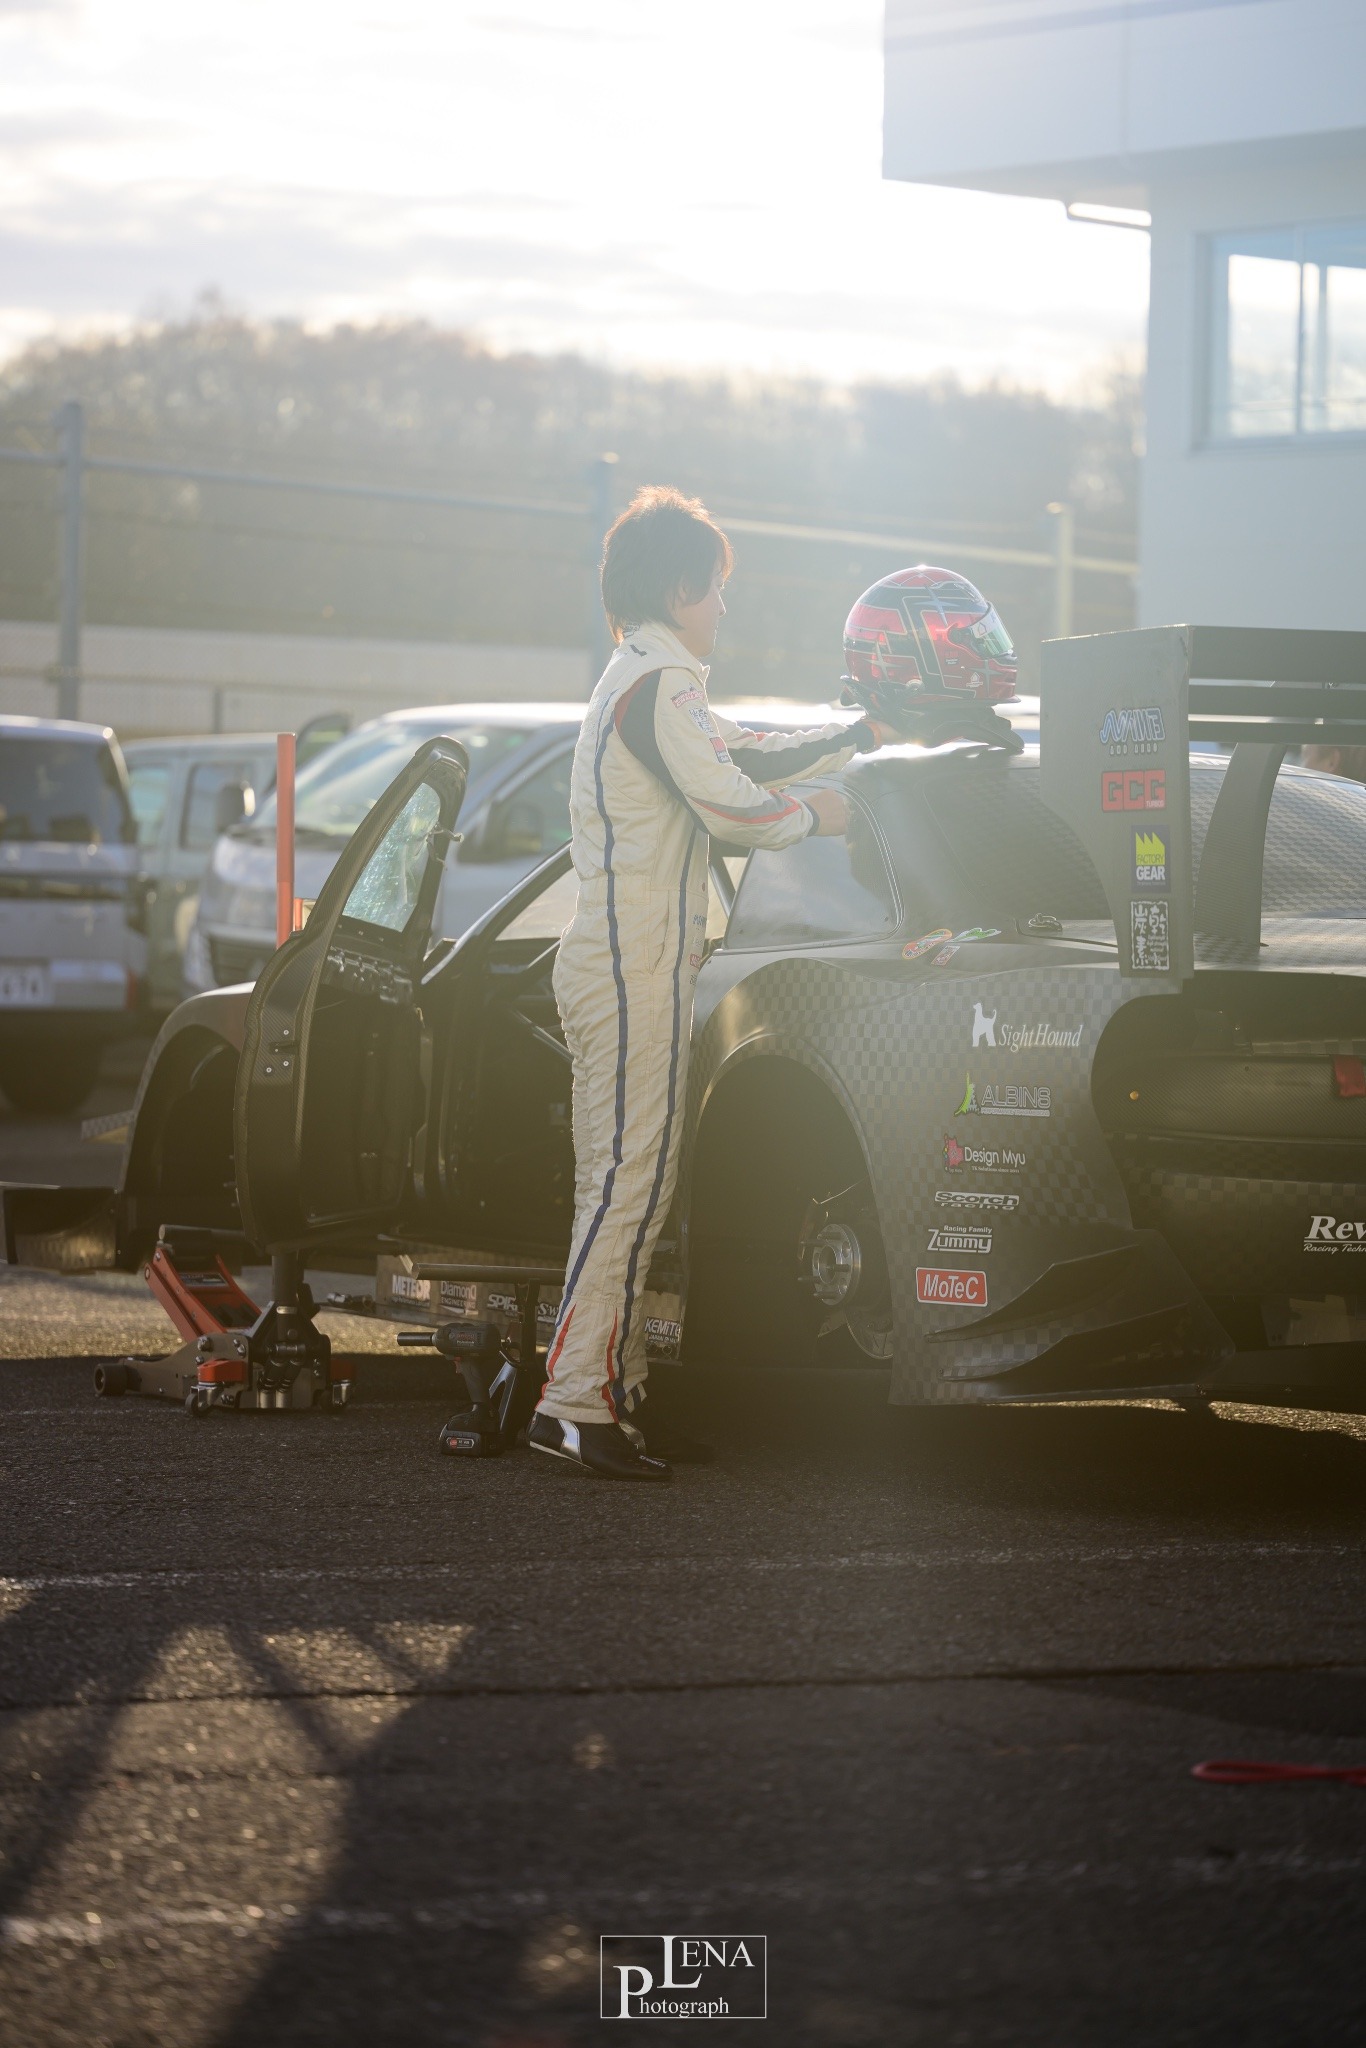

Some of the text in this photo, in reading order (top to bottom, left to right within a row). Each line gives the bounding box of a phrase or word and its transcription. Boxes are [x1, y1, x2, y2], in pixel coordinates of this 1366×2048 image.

[1102, 769, 1166, 812] GCG
[1136, 854, 1164, 864] FACTORY
[1136, 866, 1166, 881] GEAR
[981, 1084, 1051, 1109] ALBINS
[964, 1147, 1026, 1168] Design Myu
[927, 1228, 993, 1254] Zummy
[943, 1225, 993, 1234] Racing Family
[1303, 1243, 1339, 1255] Racing
[392, 1274, 431, 1301] METEOR
[923, 1273, 979, 1300] MoTeC
